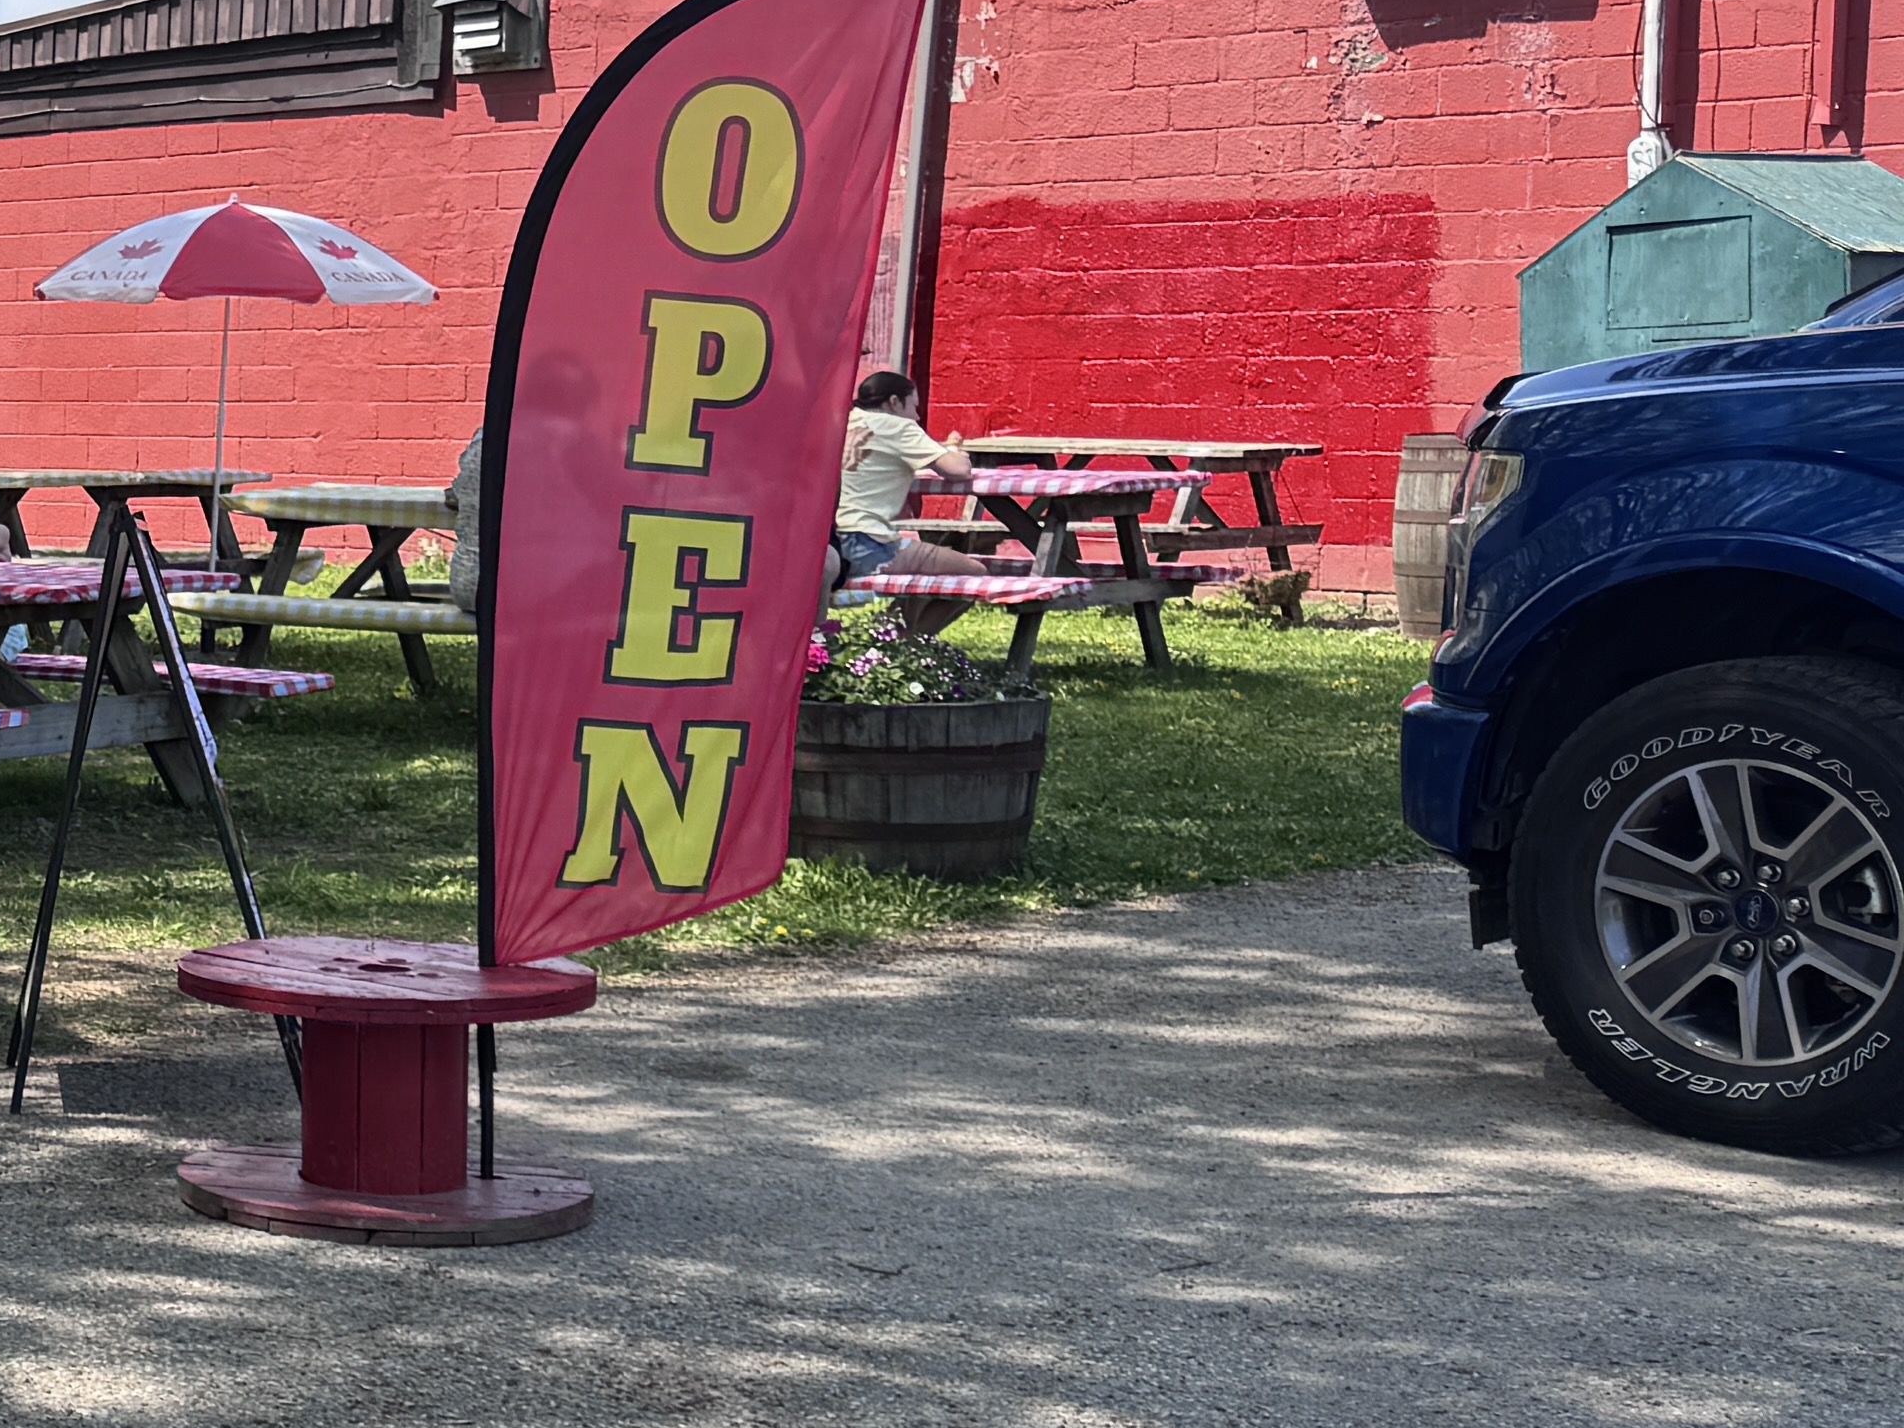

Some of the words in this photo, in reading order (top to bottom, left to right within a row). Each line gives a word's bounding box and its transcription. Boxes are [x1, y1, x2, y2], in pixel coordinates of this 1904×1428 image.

[69, 270, 148, 282] CANADA
[330, 271, 407, 284] CANADA
[556, 76, 805, 893] OPEN
[1583, 723, 1890, 818] GOODYEAR
[1587, 1008, 1891, 1100] WRANGLER
